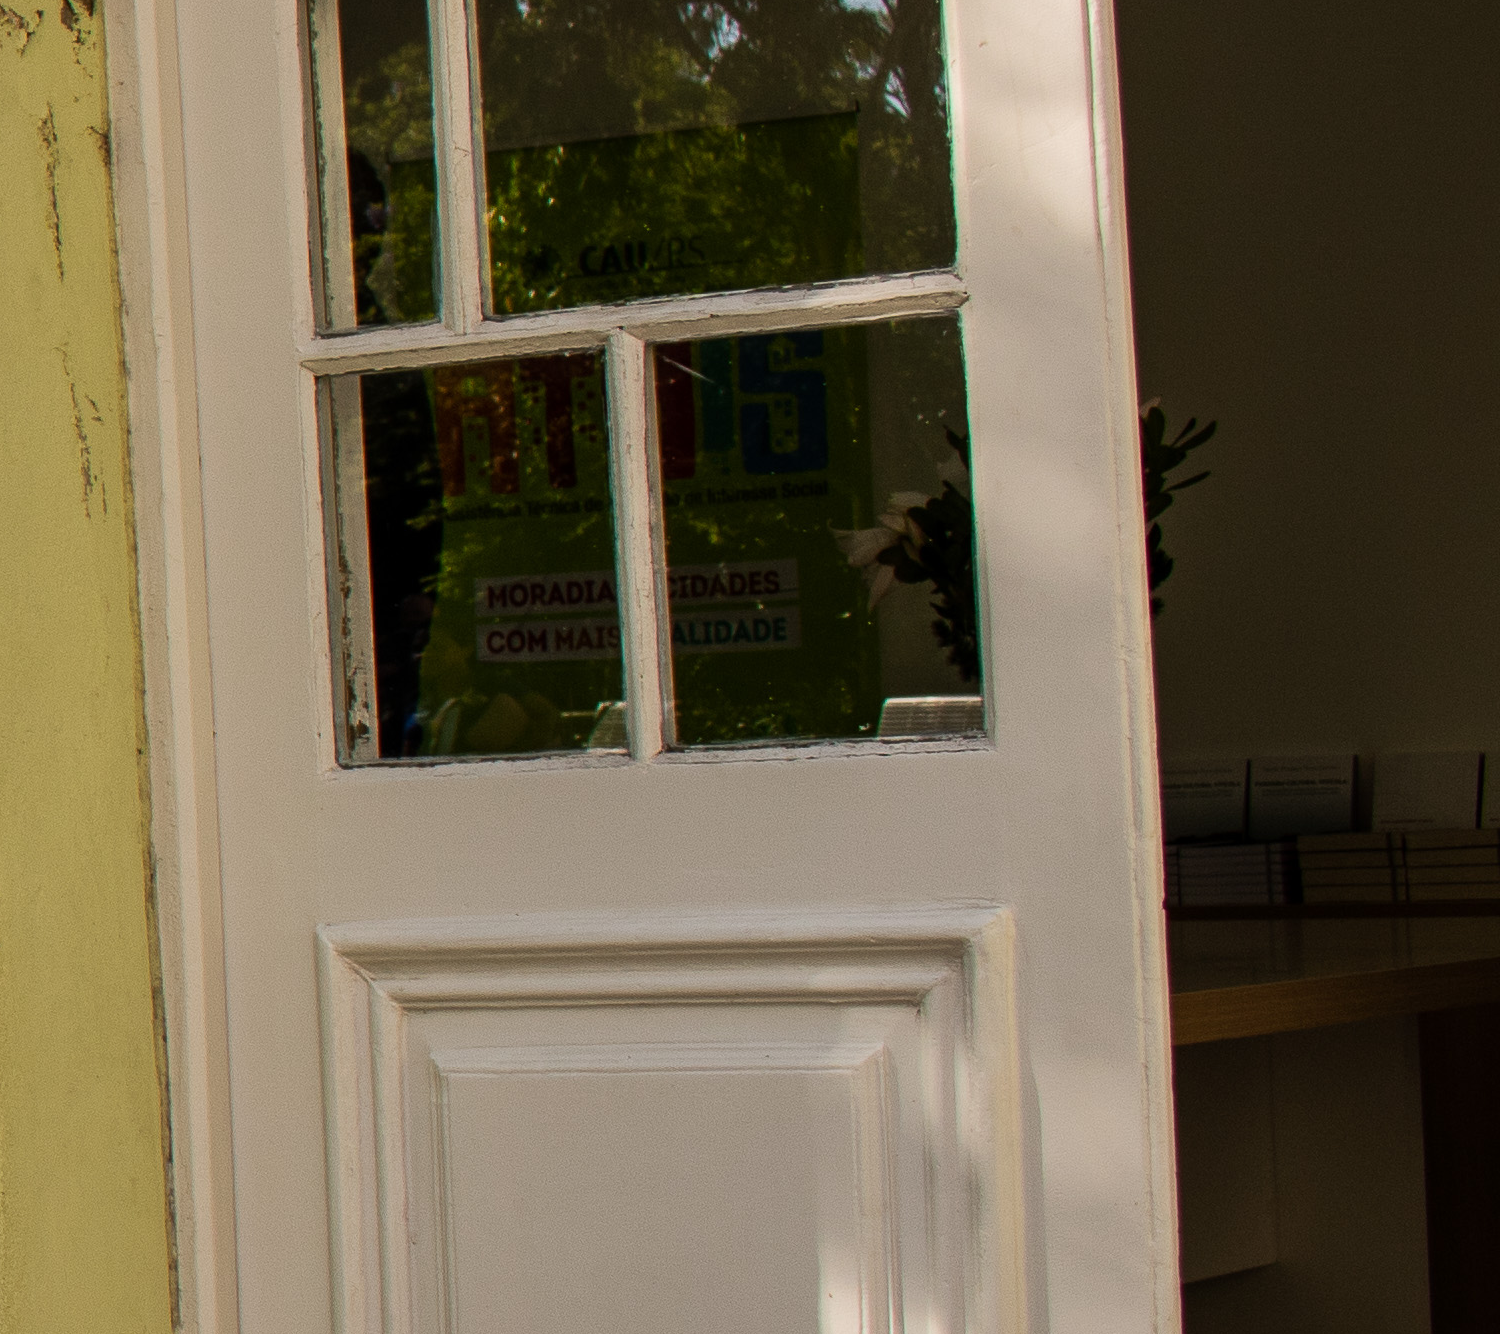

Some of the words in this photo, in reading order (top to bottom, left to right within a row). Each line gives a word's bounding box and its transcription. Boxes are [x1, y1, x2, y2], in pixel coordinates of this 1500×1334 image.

[781, 479, 829, 500] Social
[487, 580, 615, 608] MORADIA
[486, 628, 548, 654] COM
[555, 625, 620, 651] MAIS
[672, 617, 787, 646] ALIDADE
